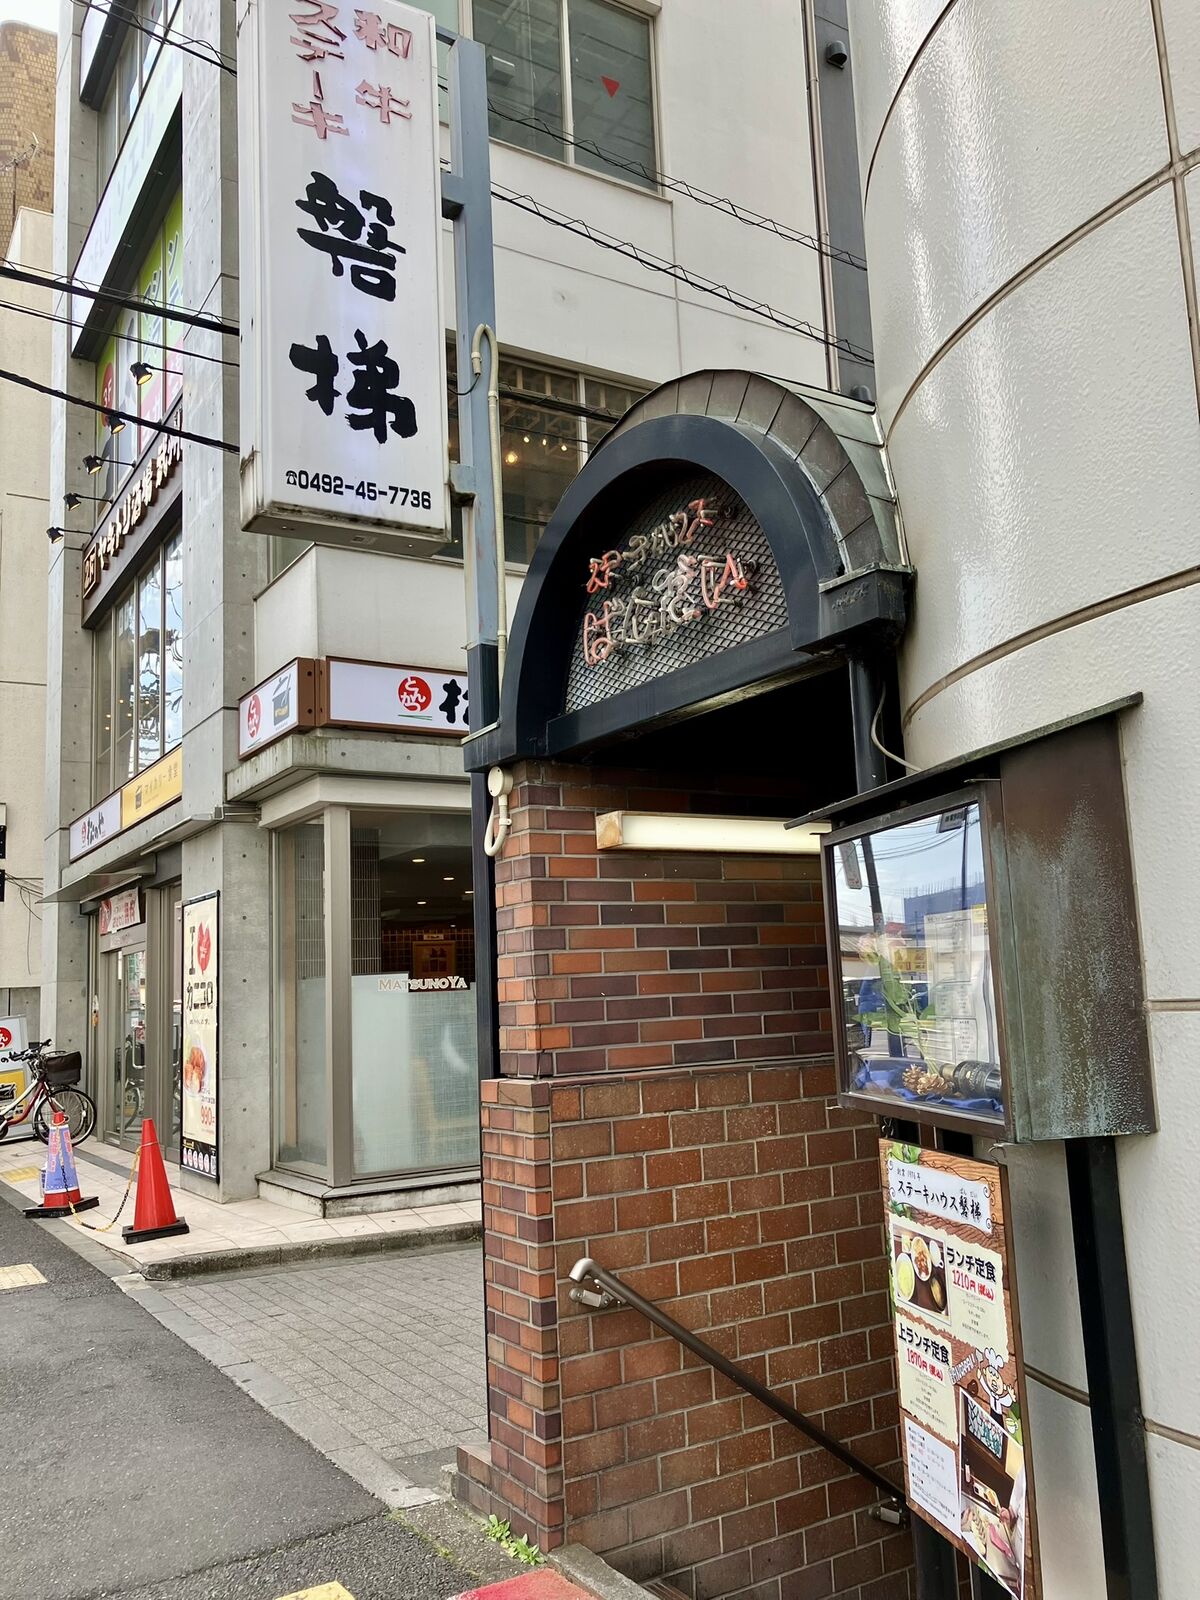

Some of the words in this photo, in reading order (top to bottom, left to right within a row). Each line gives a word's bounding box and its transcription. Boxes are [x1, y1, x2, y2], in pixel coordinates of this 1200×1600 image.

[288, 0, 349, 140] ステーキ
[352, 9, 413, 124] 和牛
[298, 470, 432, 510] 0492-45-7736
[378, 976, 468, 992] MATSUNOYA
[947, 1246, 997, 1283] ランチ定食
[952, 1269, 977, 1293] 1210円
[898, 1322, 950, 1367] 上ランチ定食
